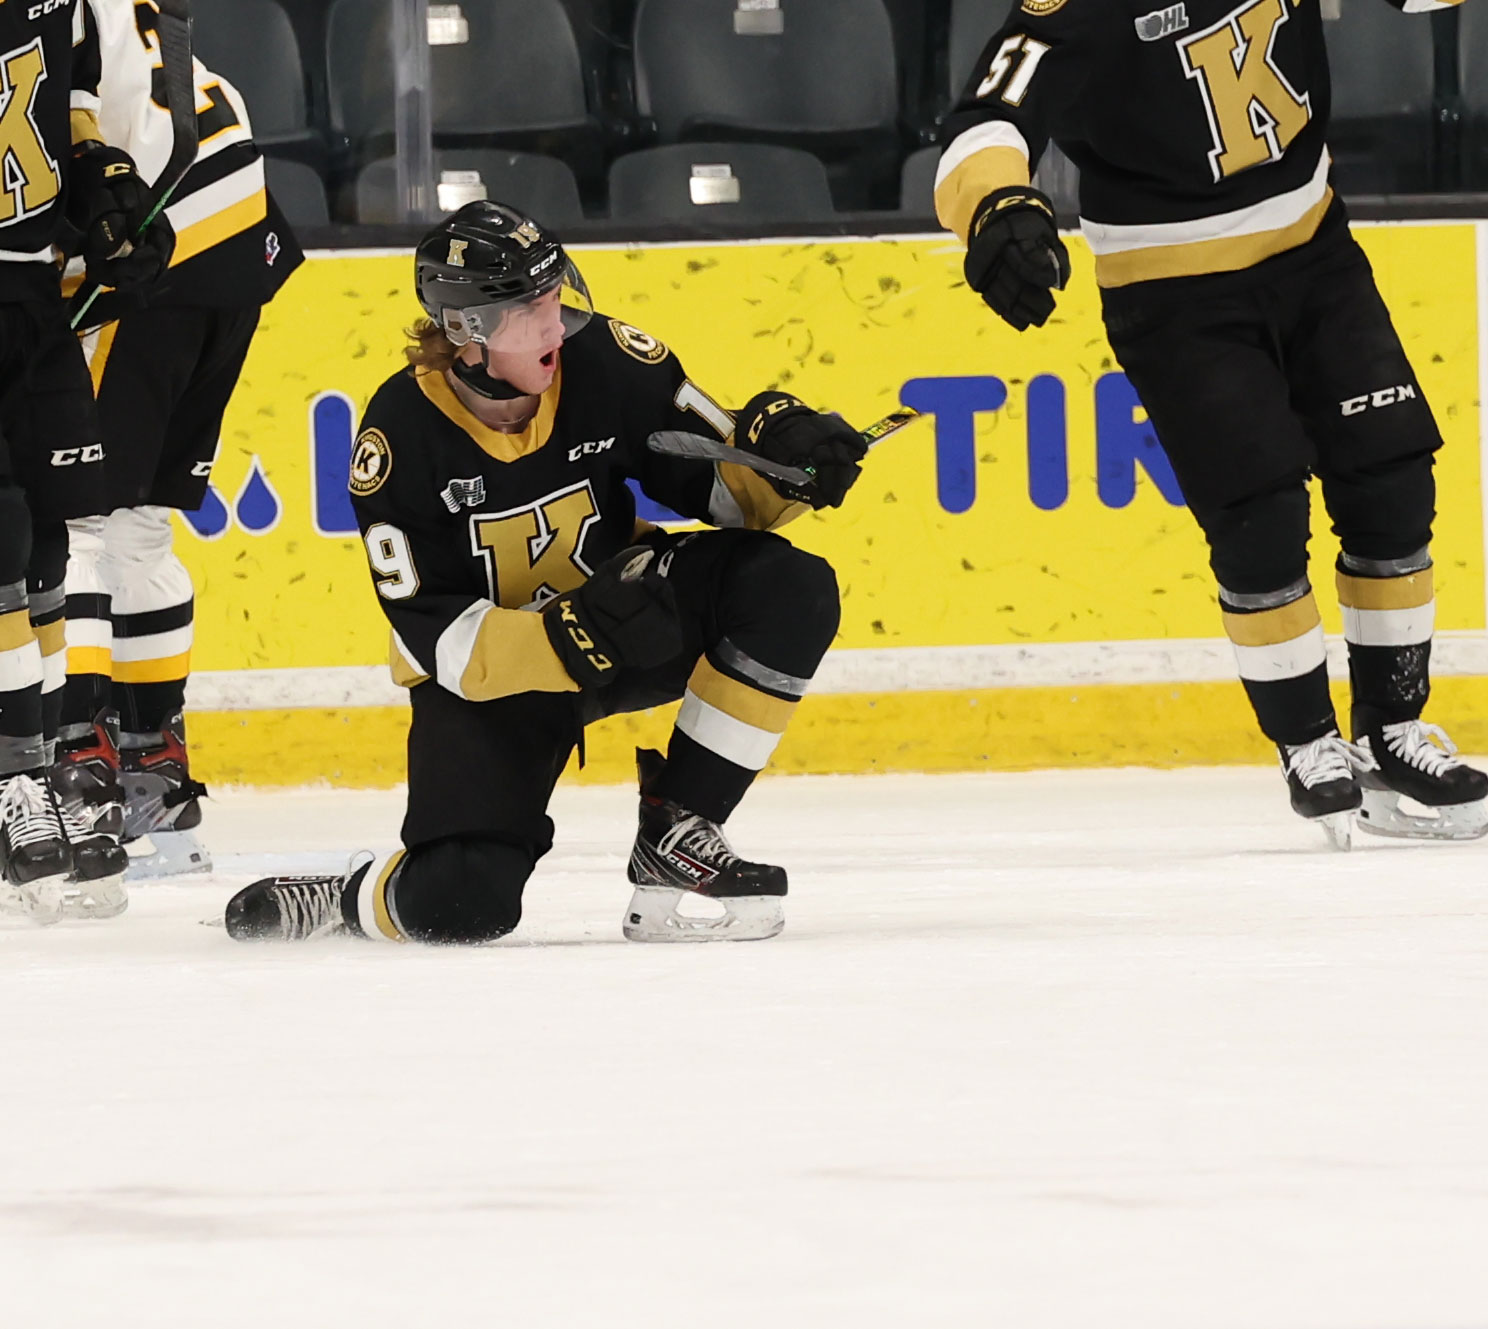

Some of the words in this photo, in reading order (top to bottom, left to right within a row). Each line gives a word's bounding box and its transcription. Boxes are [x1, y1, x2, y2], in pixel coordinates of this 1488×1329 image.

[975, 32, 1054, 108] 51
[530, 250, 558, 276] CCM
[1339, 383, 1416, 417] CCM
[356, 447, 378, 474] K
[568, 437, 616, 463] CCM
[469, 478, 602, 612] K
[560, 599, 613, 673] CCM
[666, 854, 704, 880] CCM
